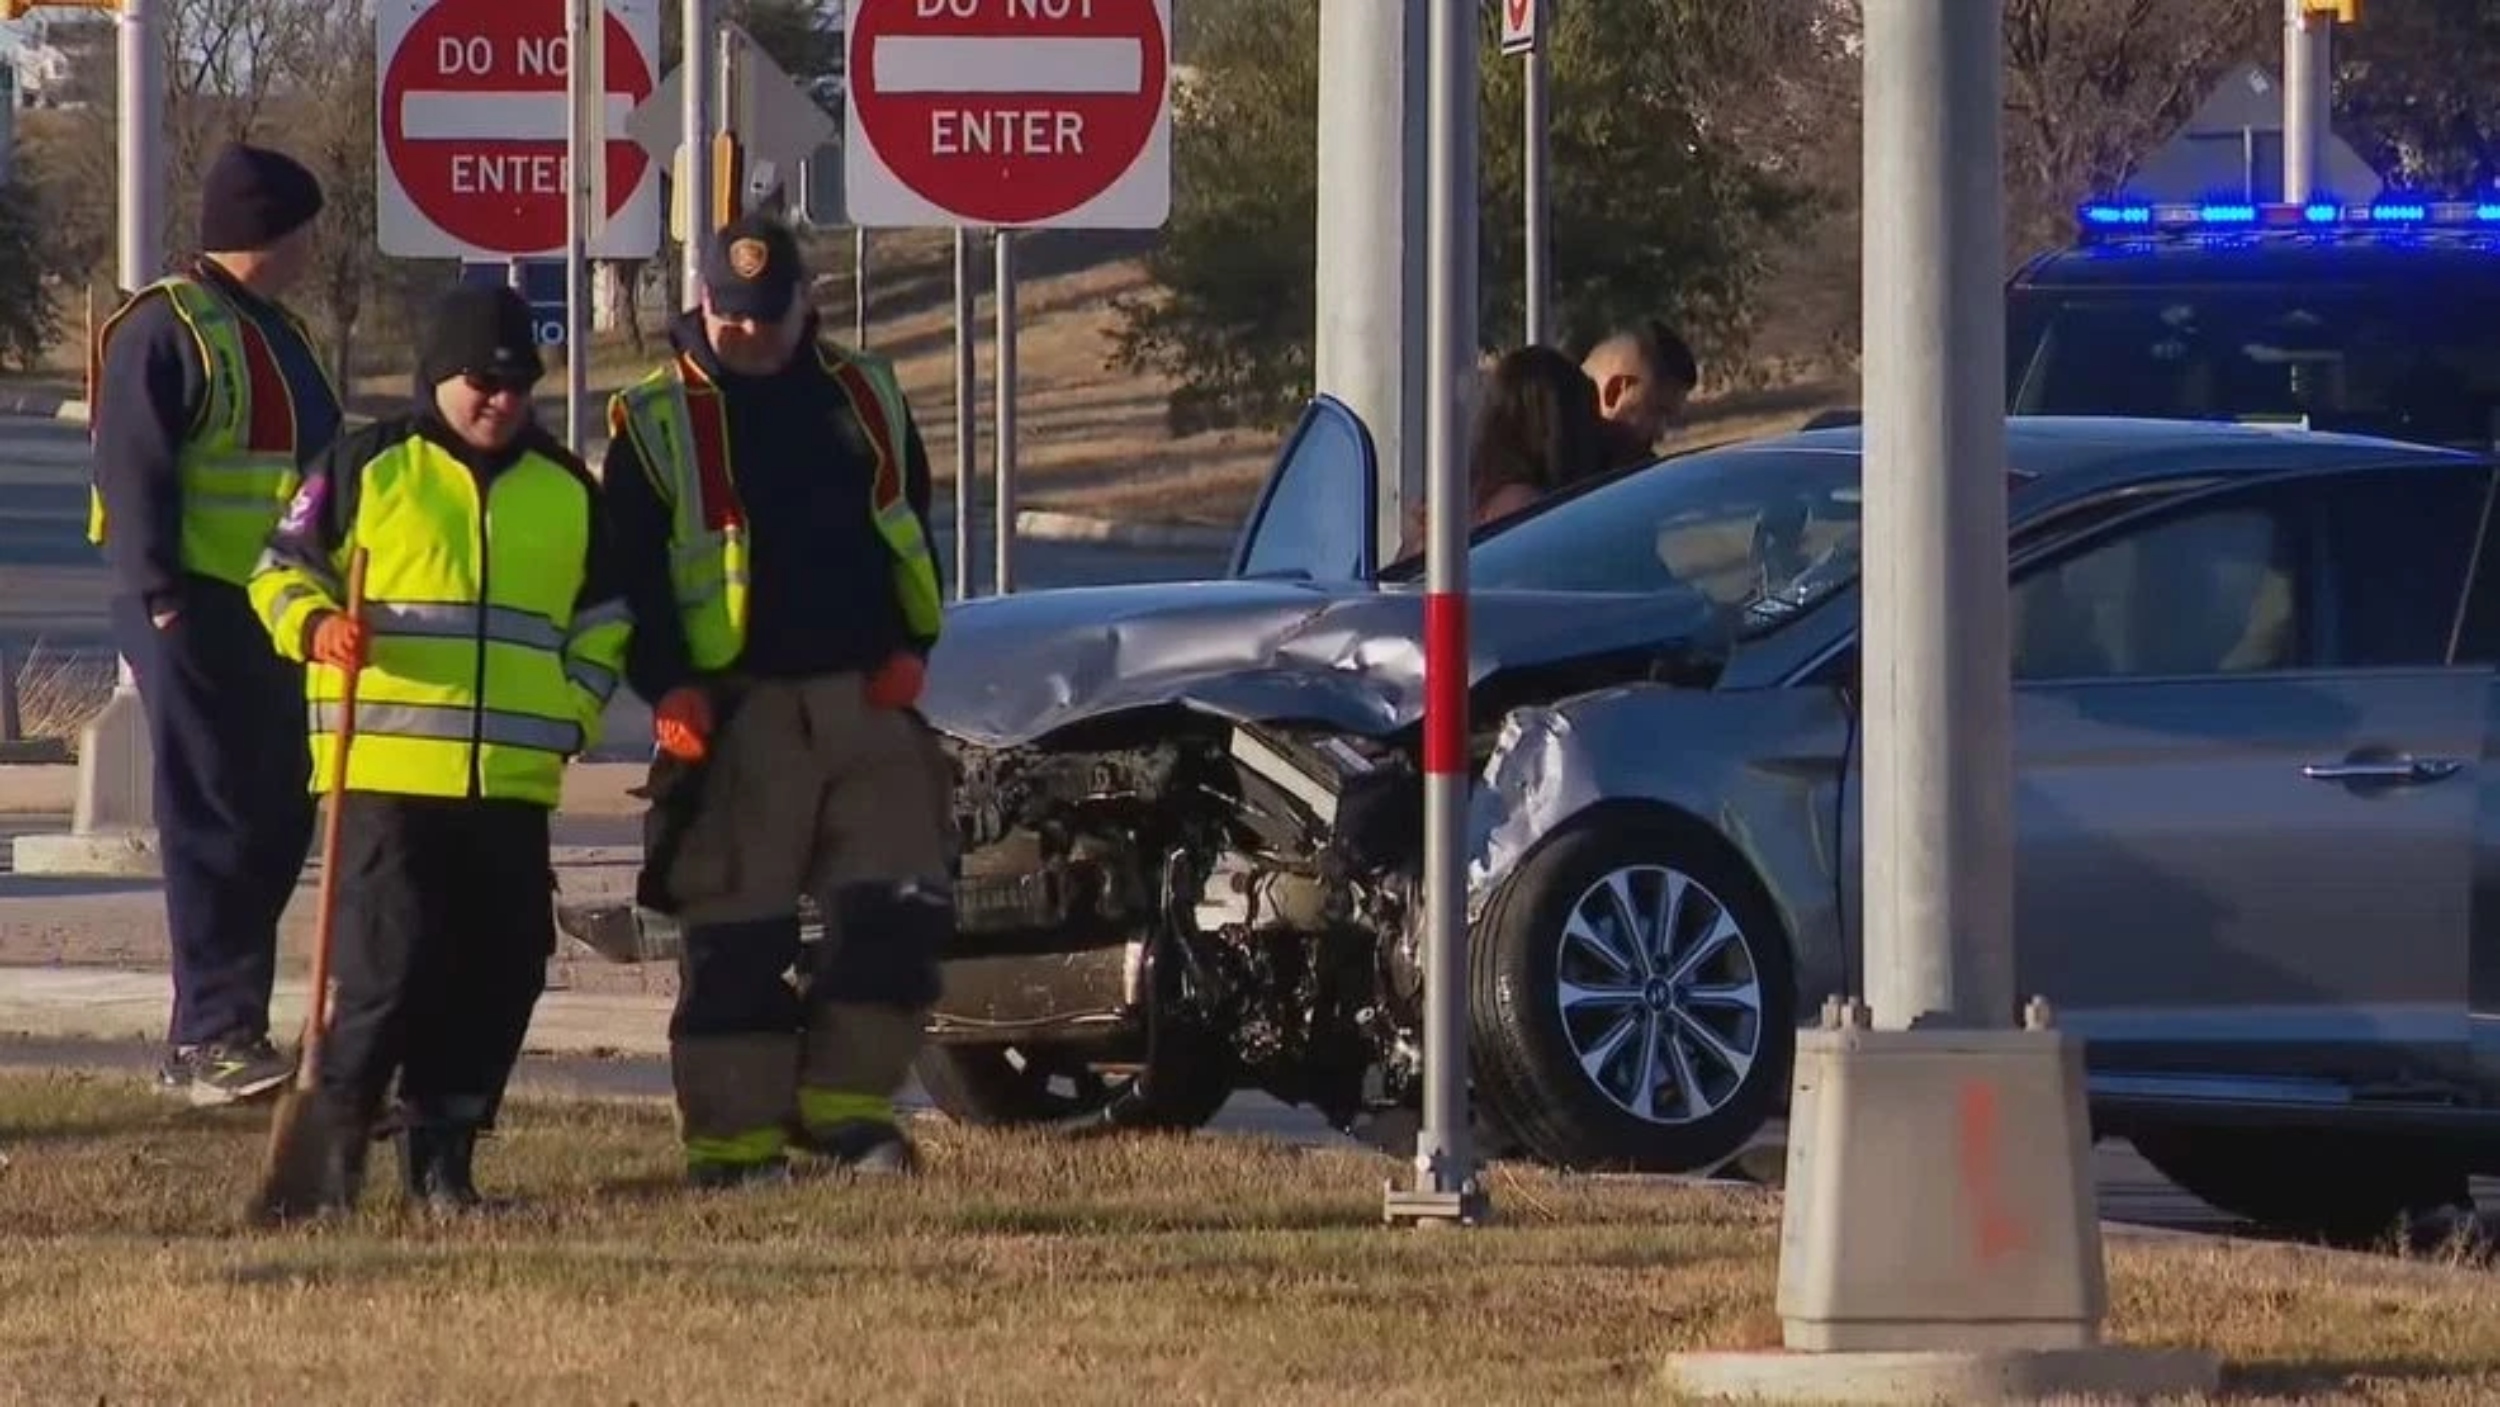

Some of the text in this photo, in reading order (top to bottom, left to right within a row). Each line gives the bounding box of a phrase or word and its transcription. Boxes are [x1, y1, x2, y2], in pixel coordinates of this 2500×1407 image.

[438, 36, 569, 76] DO NO
[931, 109, 1084, 154] ENTER
